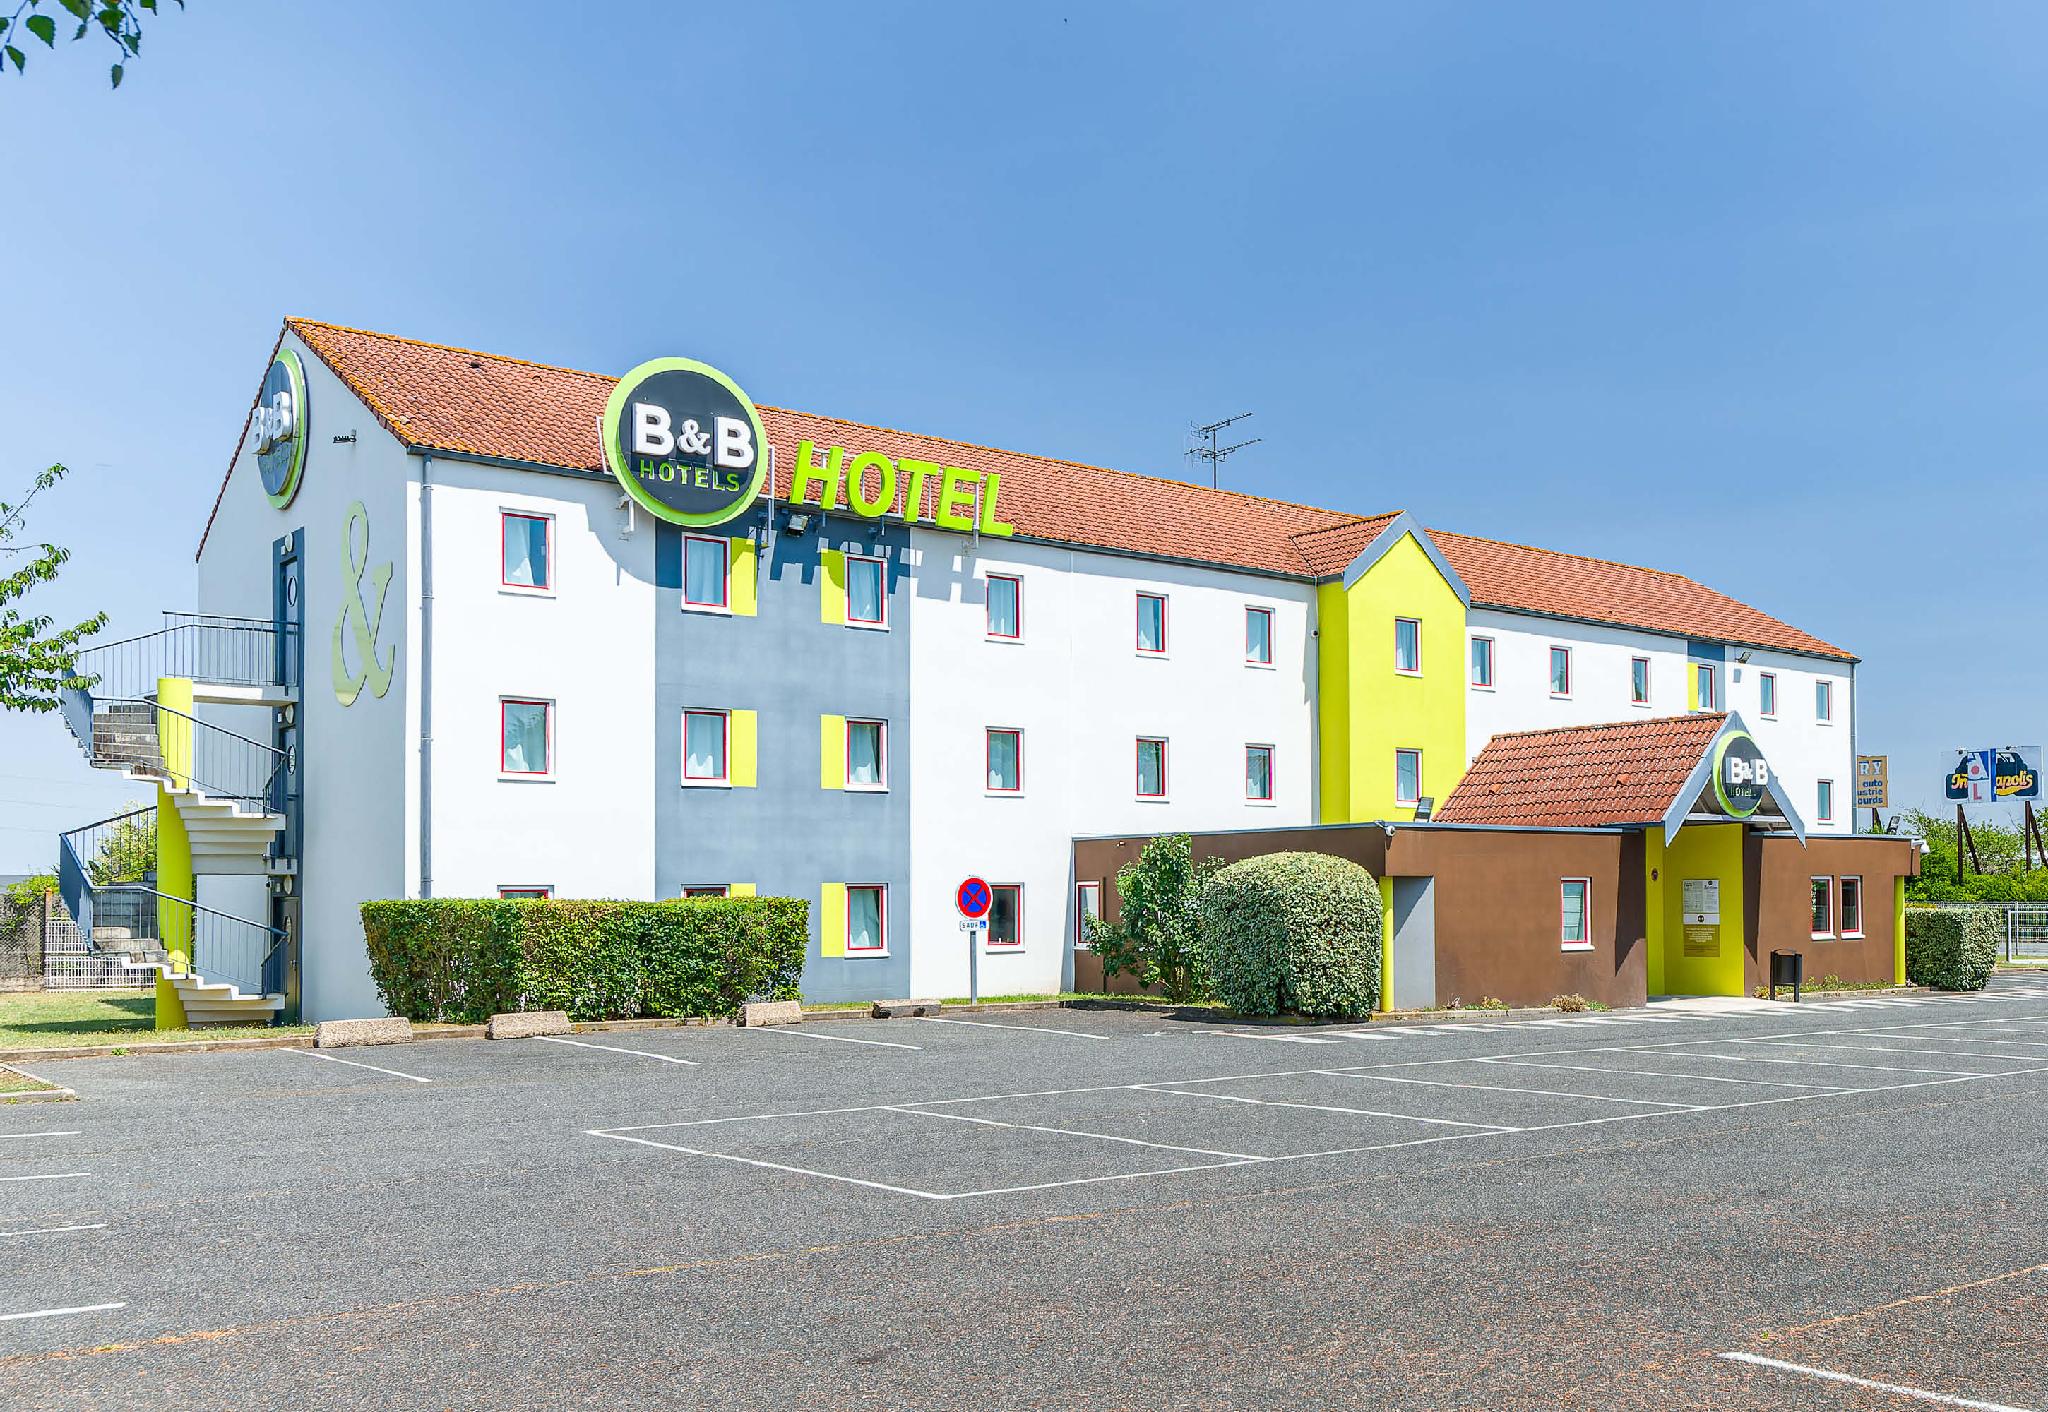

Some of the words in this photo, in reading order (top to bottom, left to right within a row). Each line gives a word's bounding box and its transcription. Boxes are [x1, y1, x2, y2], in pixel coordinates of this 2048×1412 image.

[632, 402, 754, 468] B&B
[640, 459, 740, 492] HOTELS
[789, 440, 1014, 536] HOTEL
[1726, 757, 1768, 785] B&B
